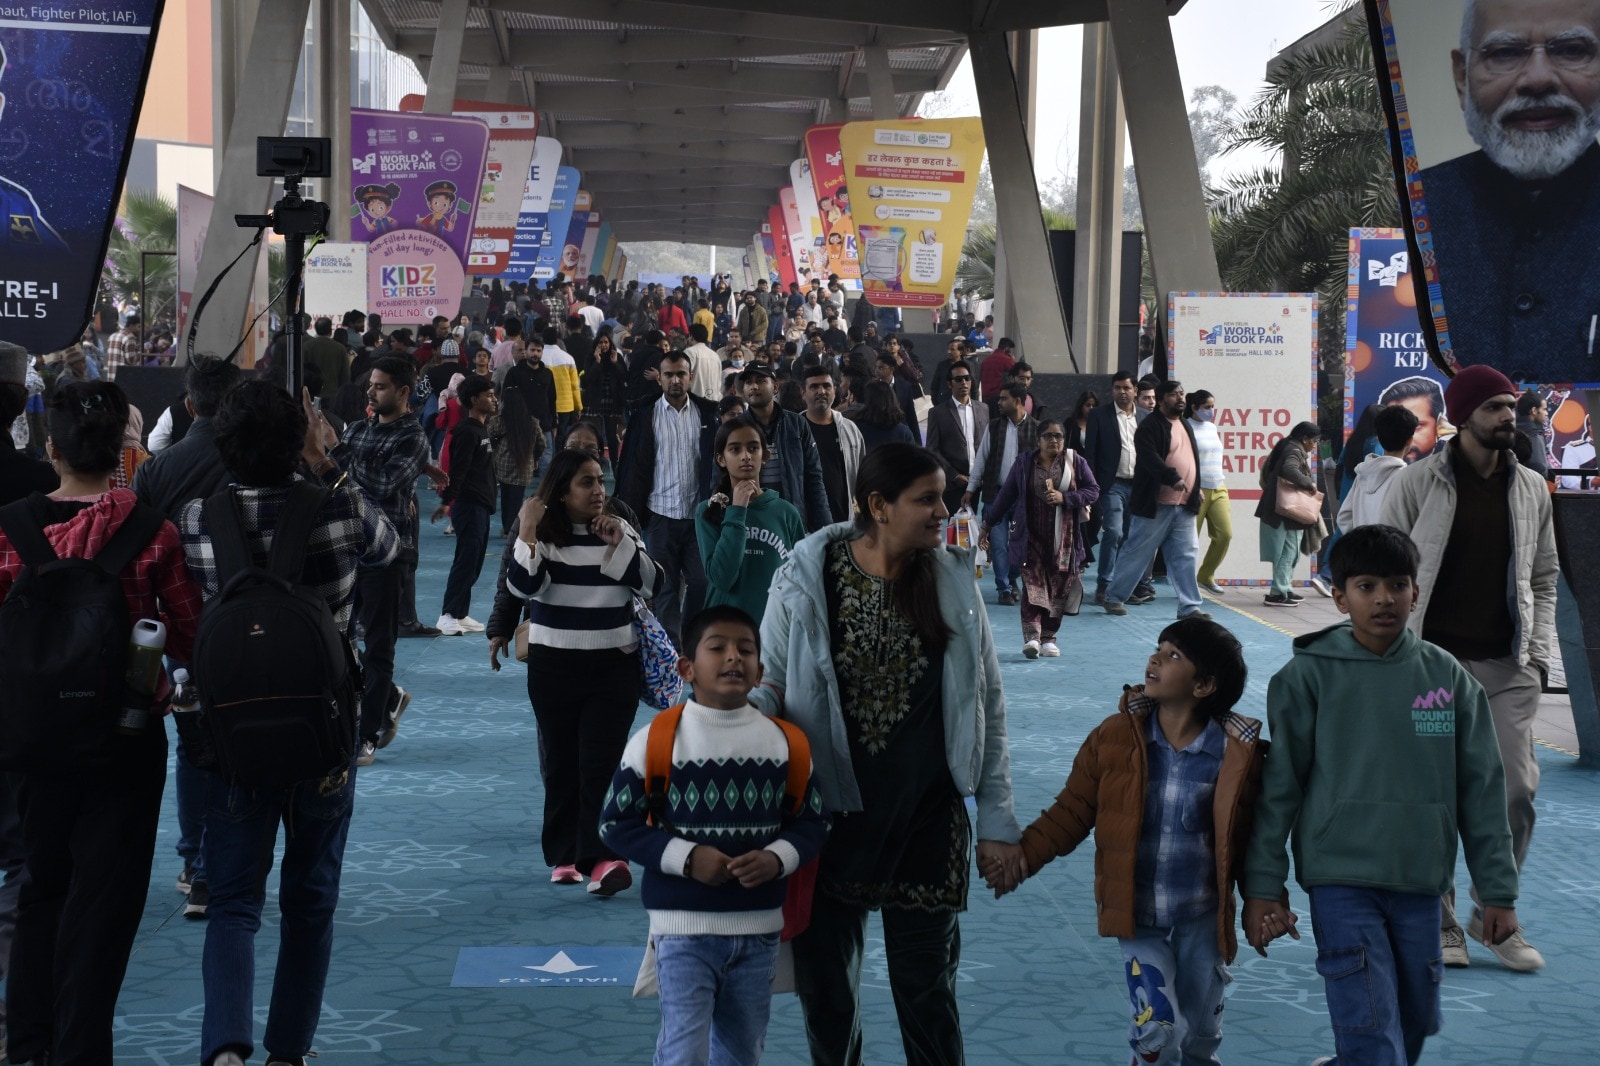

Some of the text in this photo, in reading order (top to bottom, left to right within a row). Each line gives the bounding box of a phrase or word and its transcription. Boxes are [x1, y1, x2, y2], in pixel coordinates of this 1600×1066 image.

[31, 7, 76, 21] Fighter
[79, 9, 110, 22] Pilot,
[113, 10, 137, 24] IAF)
[380, 154, 419, 164] WORLD
[867, 154, 878, 163] हर
[880, 153, 901, 163] लेबल
[903, 156, 919, 166] कुछ
[921, 157, 944, 166] कहता
[380, 162, 410, 171] BOOK
[413, 161, 436, 170] FAIR
[408, 233, 448, 252] Activities
[383, 243, 434, 257] all day long!
[381, 264, 435, 287] KIDZ
[382, 285, 436, 298] EXPRESS
[0, 302, 47, 318] LL 5
[381, 307, 434, 318] HALL NO. 6
[1224, 326, 1266, 336] WORLD
[1224, 335, 1284, 344] BOOK FAIR
[1198, 348, 1213, 357] 10-18
[1394, 351, 1428, 371] KEJ
[1258, 408, 1291, 427] TO
[1220, 432, 1286, 450] ETRO
[1221, 455, 1266, 473] ATI
[59, 690, 96, 698] Lenovo
